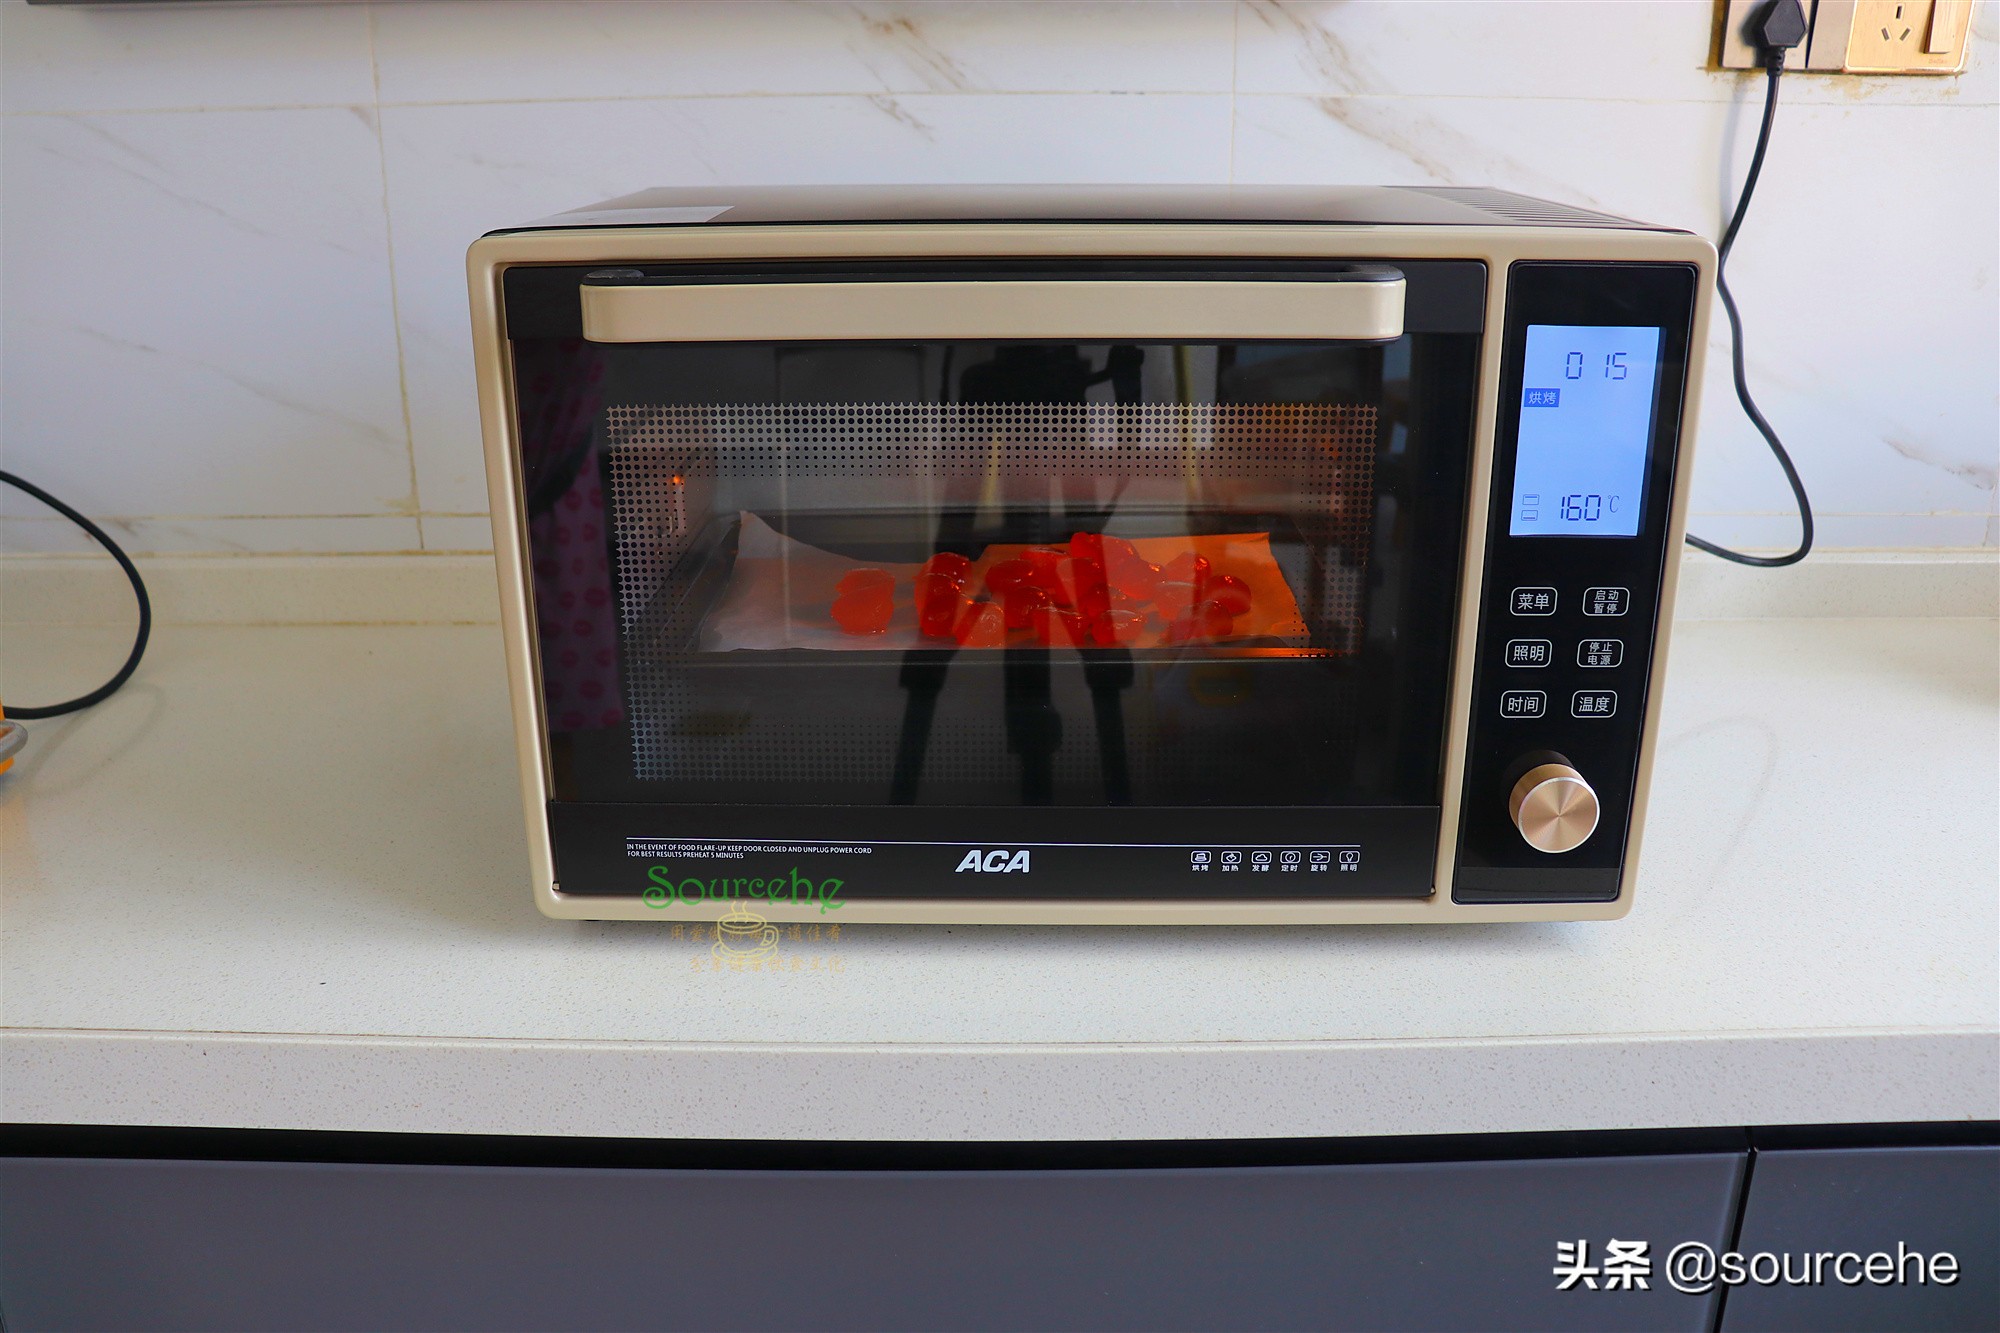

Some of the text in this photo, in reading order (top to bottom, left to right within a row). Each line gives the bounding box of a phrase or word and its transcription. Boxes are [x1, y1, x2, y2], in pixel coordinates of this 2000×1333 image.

[1528, 391, 1557, 405] 烘烤
[1560, 494, 1601, 521] 160
[1517, 593, 1550, 610] 菜单
[1594, 590, 1620, 601] 启动
[1593, 603, 1618, 614] 暂停
[1512, 645, 1545, 662] 照明
[1589, 641, 1613, 652] 停止
[1587, 655, 1611, 666] 电源
[1507, 696, 1539, 713] 时间
[1578, 696, 1610, 713] 温度
[763, 845, 787, 853] CLOSED
[830, 846, 853, 854] POWER
[955, 849, 1030, 873] ACA
[1221, 864, 1239, 872] 加热
[1251, 864, 1270, 872] 发酵
[1280, 864, 1299, 872] 定时
[1310, 864, 1328, 872] 旋转
[1340, 864, 1358, 872] 照明
